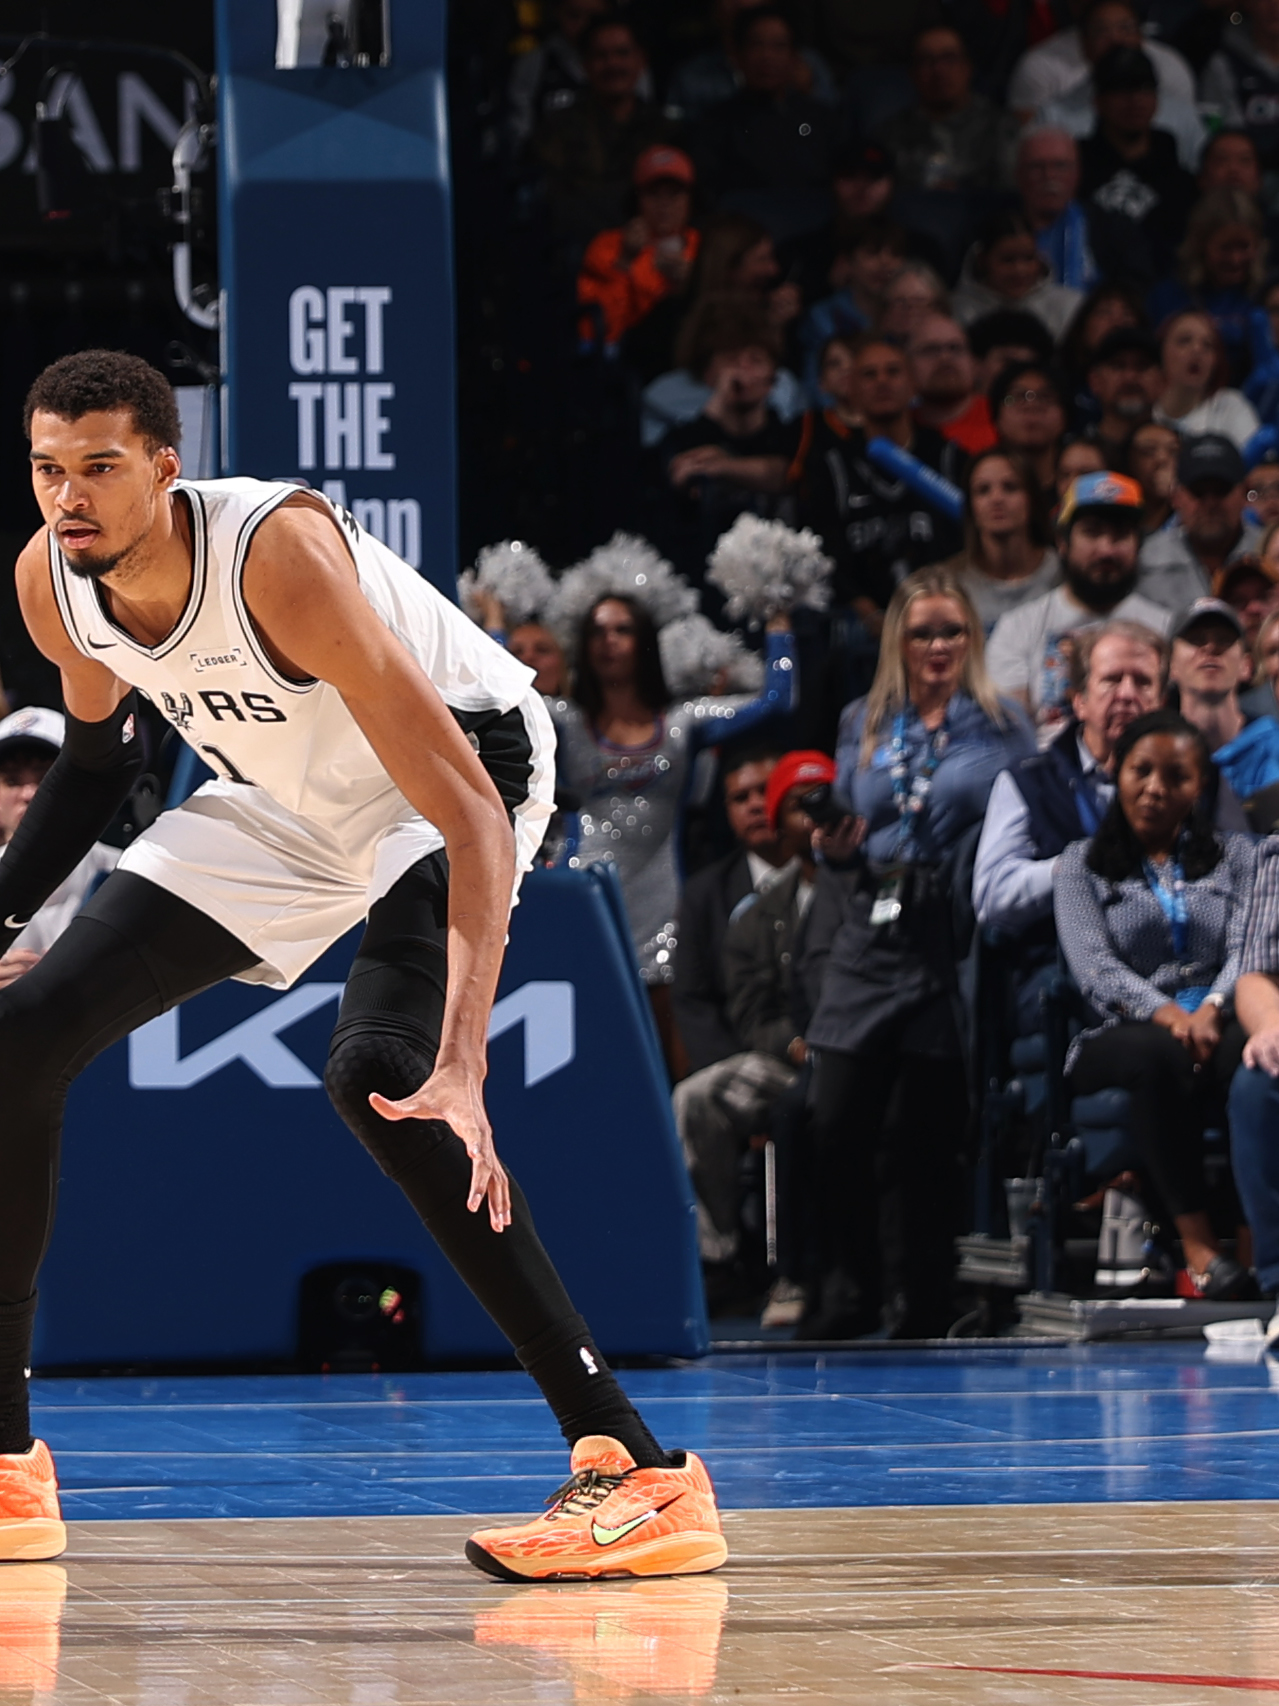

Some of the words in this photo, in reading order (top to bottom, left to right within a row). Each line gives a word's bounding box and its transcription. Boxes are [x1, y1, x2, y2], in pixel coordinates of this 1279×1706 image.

[288, 286, 393, 375] GET
[288, 382, 396, 471] THE
[197, 654, 238, 667] LEDGER
